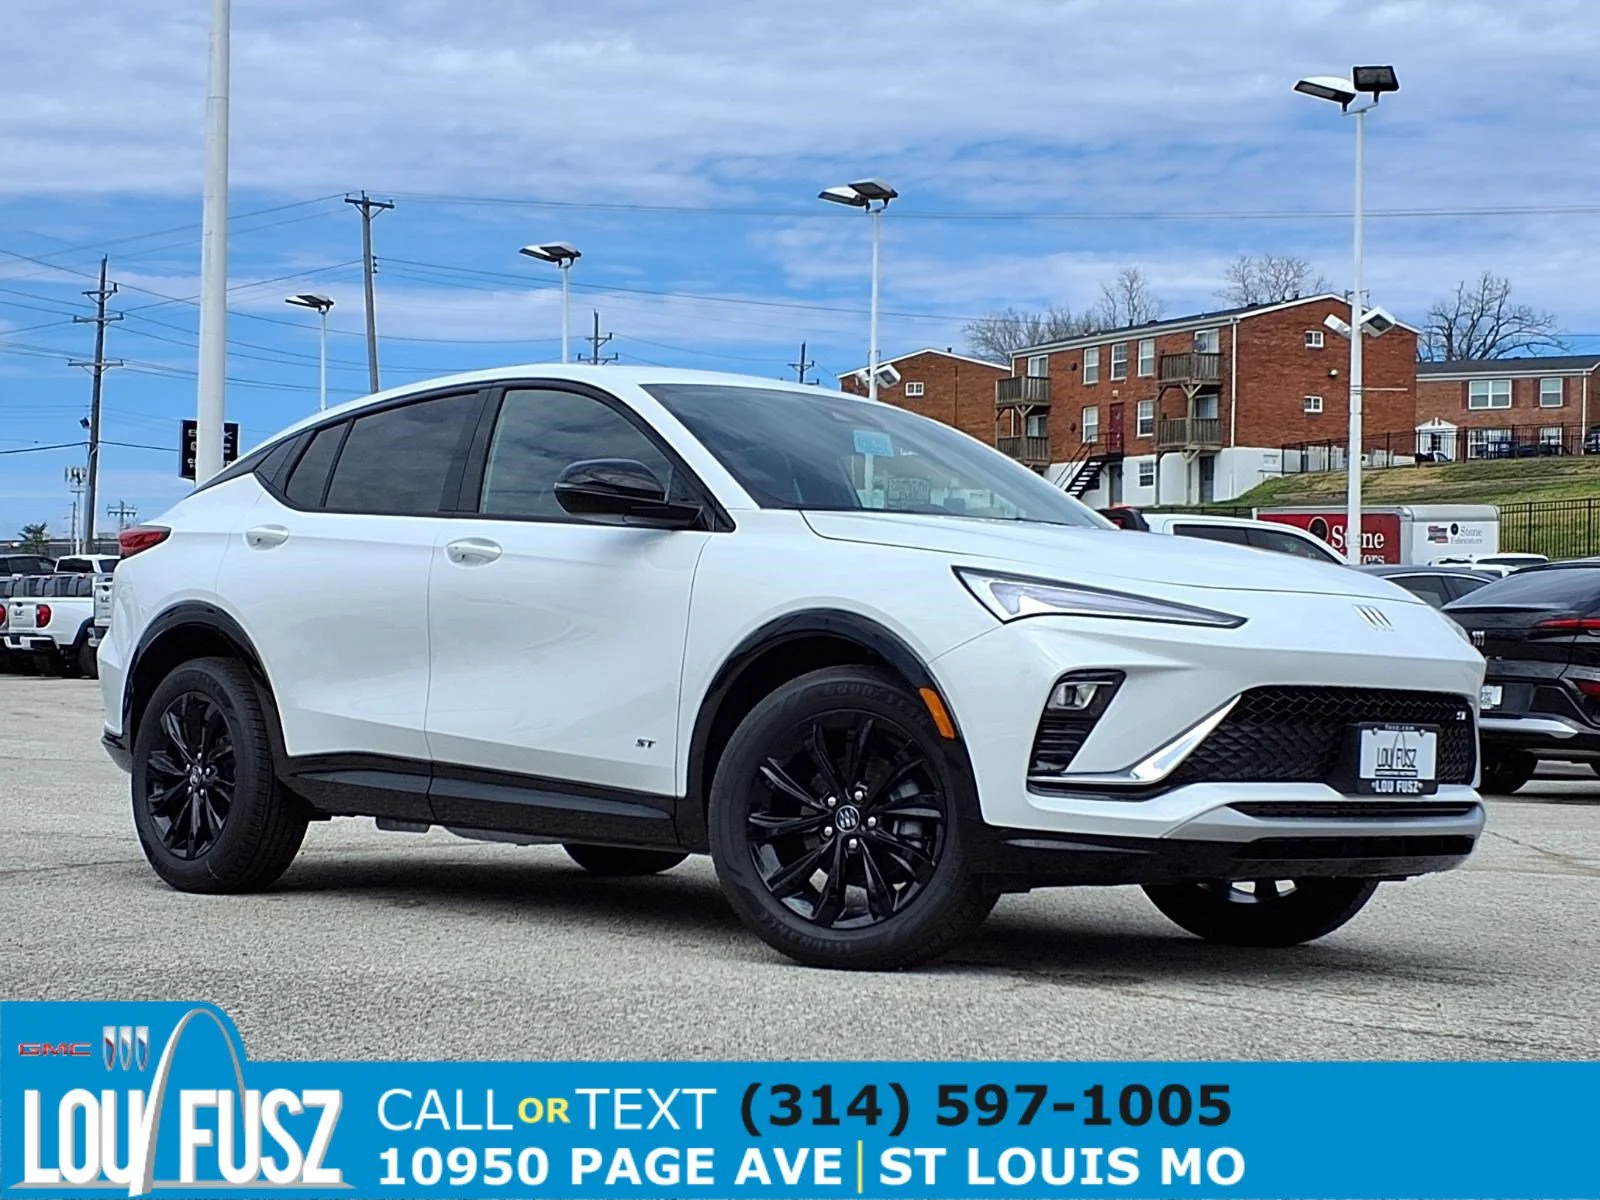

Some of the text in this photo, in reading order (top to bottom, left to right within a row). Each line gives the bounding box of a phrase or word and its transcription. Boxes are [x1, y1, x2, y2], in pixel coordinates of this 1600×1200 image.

[1331, 524, 1385, 549] Stne
[635, 738, 657, 749] ST
[1377, 747, 1417, 769] LOU FUSZ
[1375, 779, 1420, 794] LOU FUSZ
